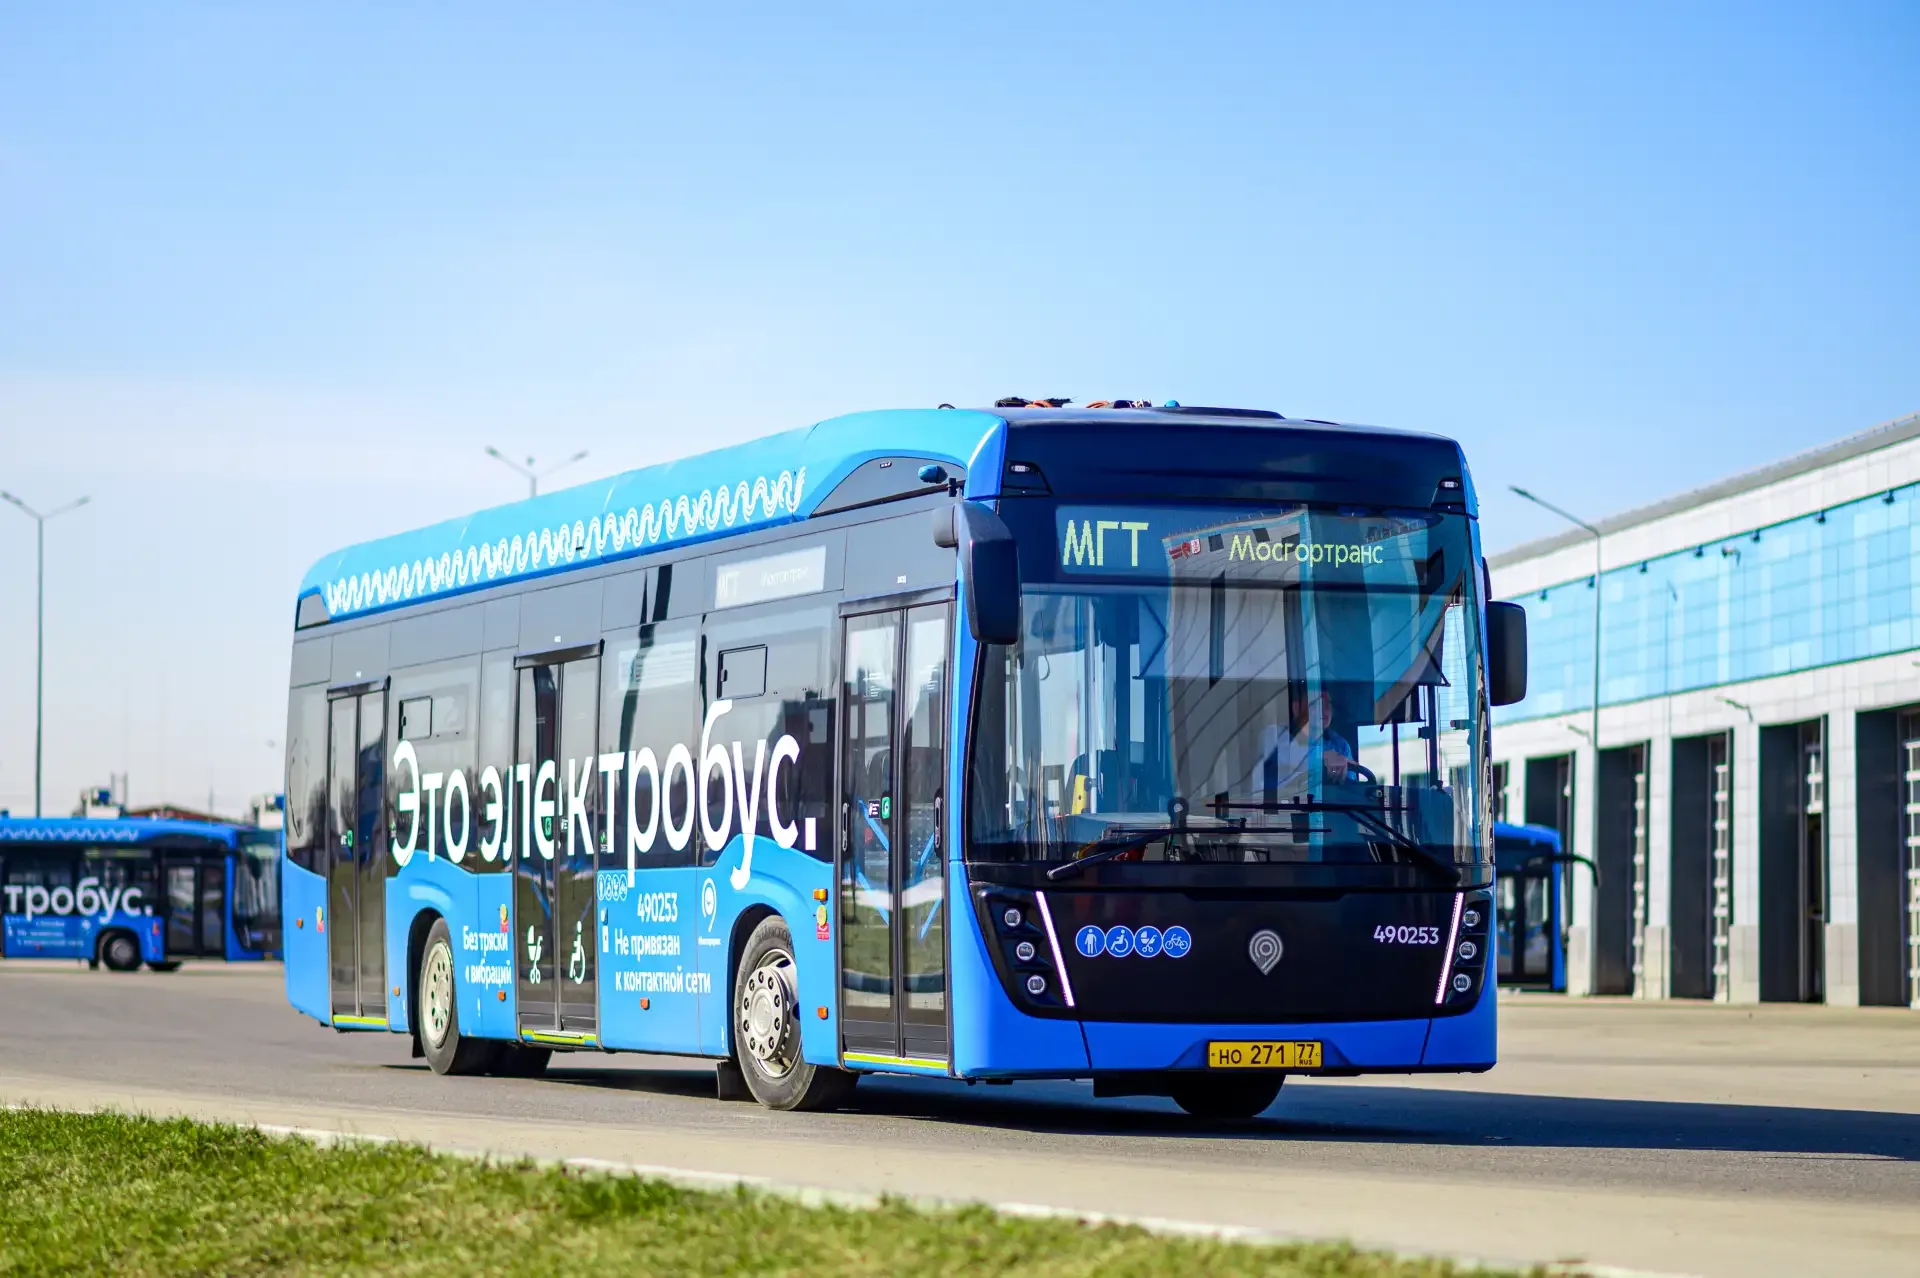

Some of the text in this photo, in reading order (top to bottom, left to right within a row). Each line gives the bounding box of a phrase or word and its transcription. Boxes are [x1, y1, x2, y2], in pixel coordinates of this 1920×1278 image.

[1063, 519, 1384, 568] МГТ Мосгортранс
[392, 740, 470, 867] Это
[3, 877, 153, 924] тробус.
[637, 892, 678, 922] 490253
[463, 925, 509, 957] Без тряски
[615, 928, 680, 961] Не привязан
[1373, 925, 1439, 945] 490253
[471, 958, 512, 990] вибраций
[615, 965, 711, 993] к контактной сети
[1250, 1044, 1285, 1065] 271
[1297, 1043, 1315, 1059] 77
